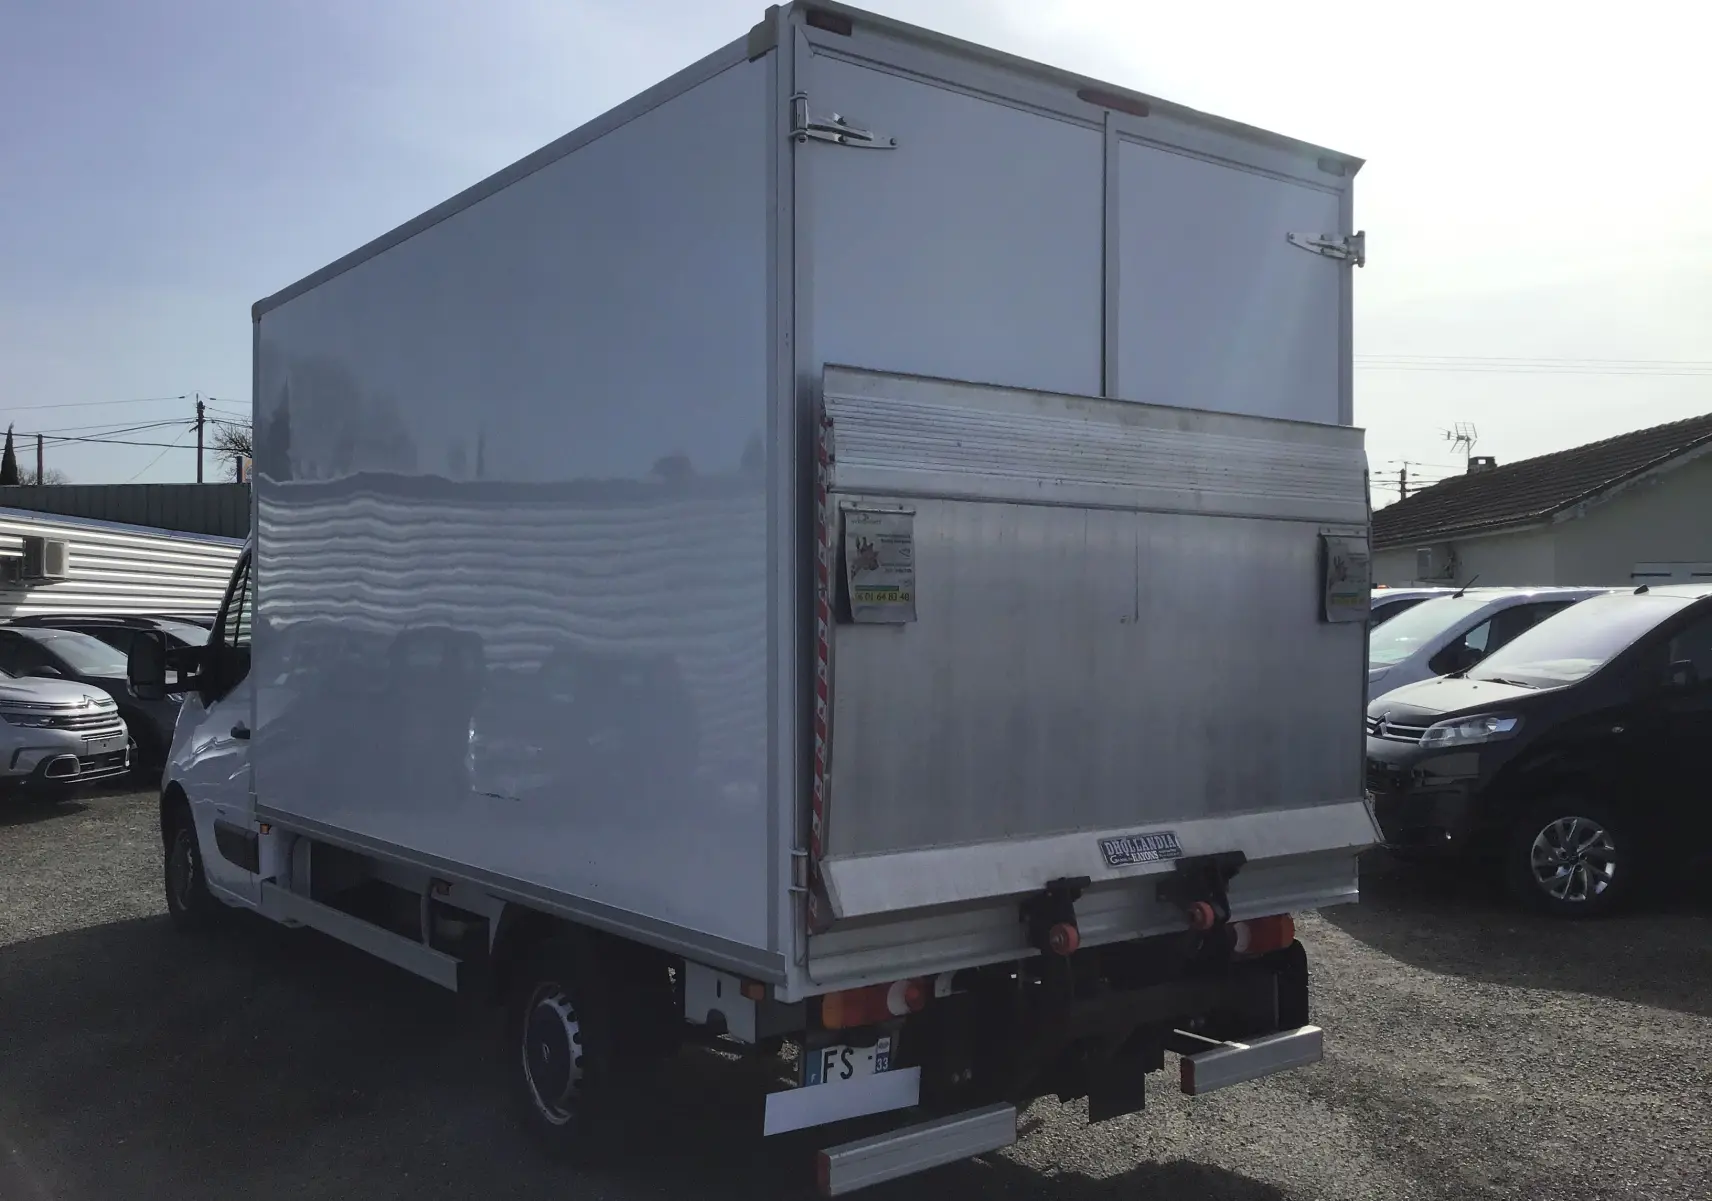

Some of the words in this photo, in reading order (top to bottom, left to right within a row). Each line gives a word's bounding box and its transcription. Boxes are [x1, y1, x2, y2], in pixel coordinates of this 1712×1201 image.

[1104, 834, 1176, 856] DHOLLANDIA
[823, 1047, 854, 1083] FS
[876, 1058, 888, 1071] 33
